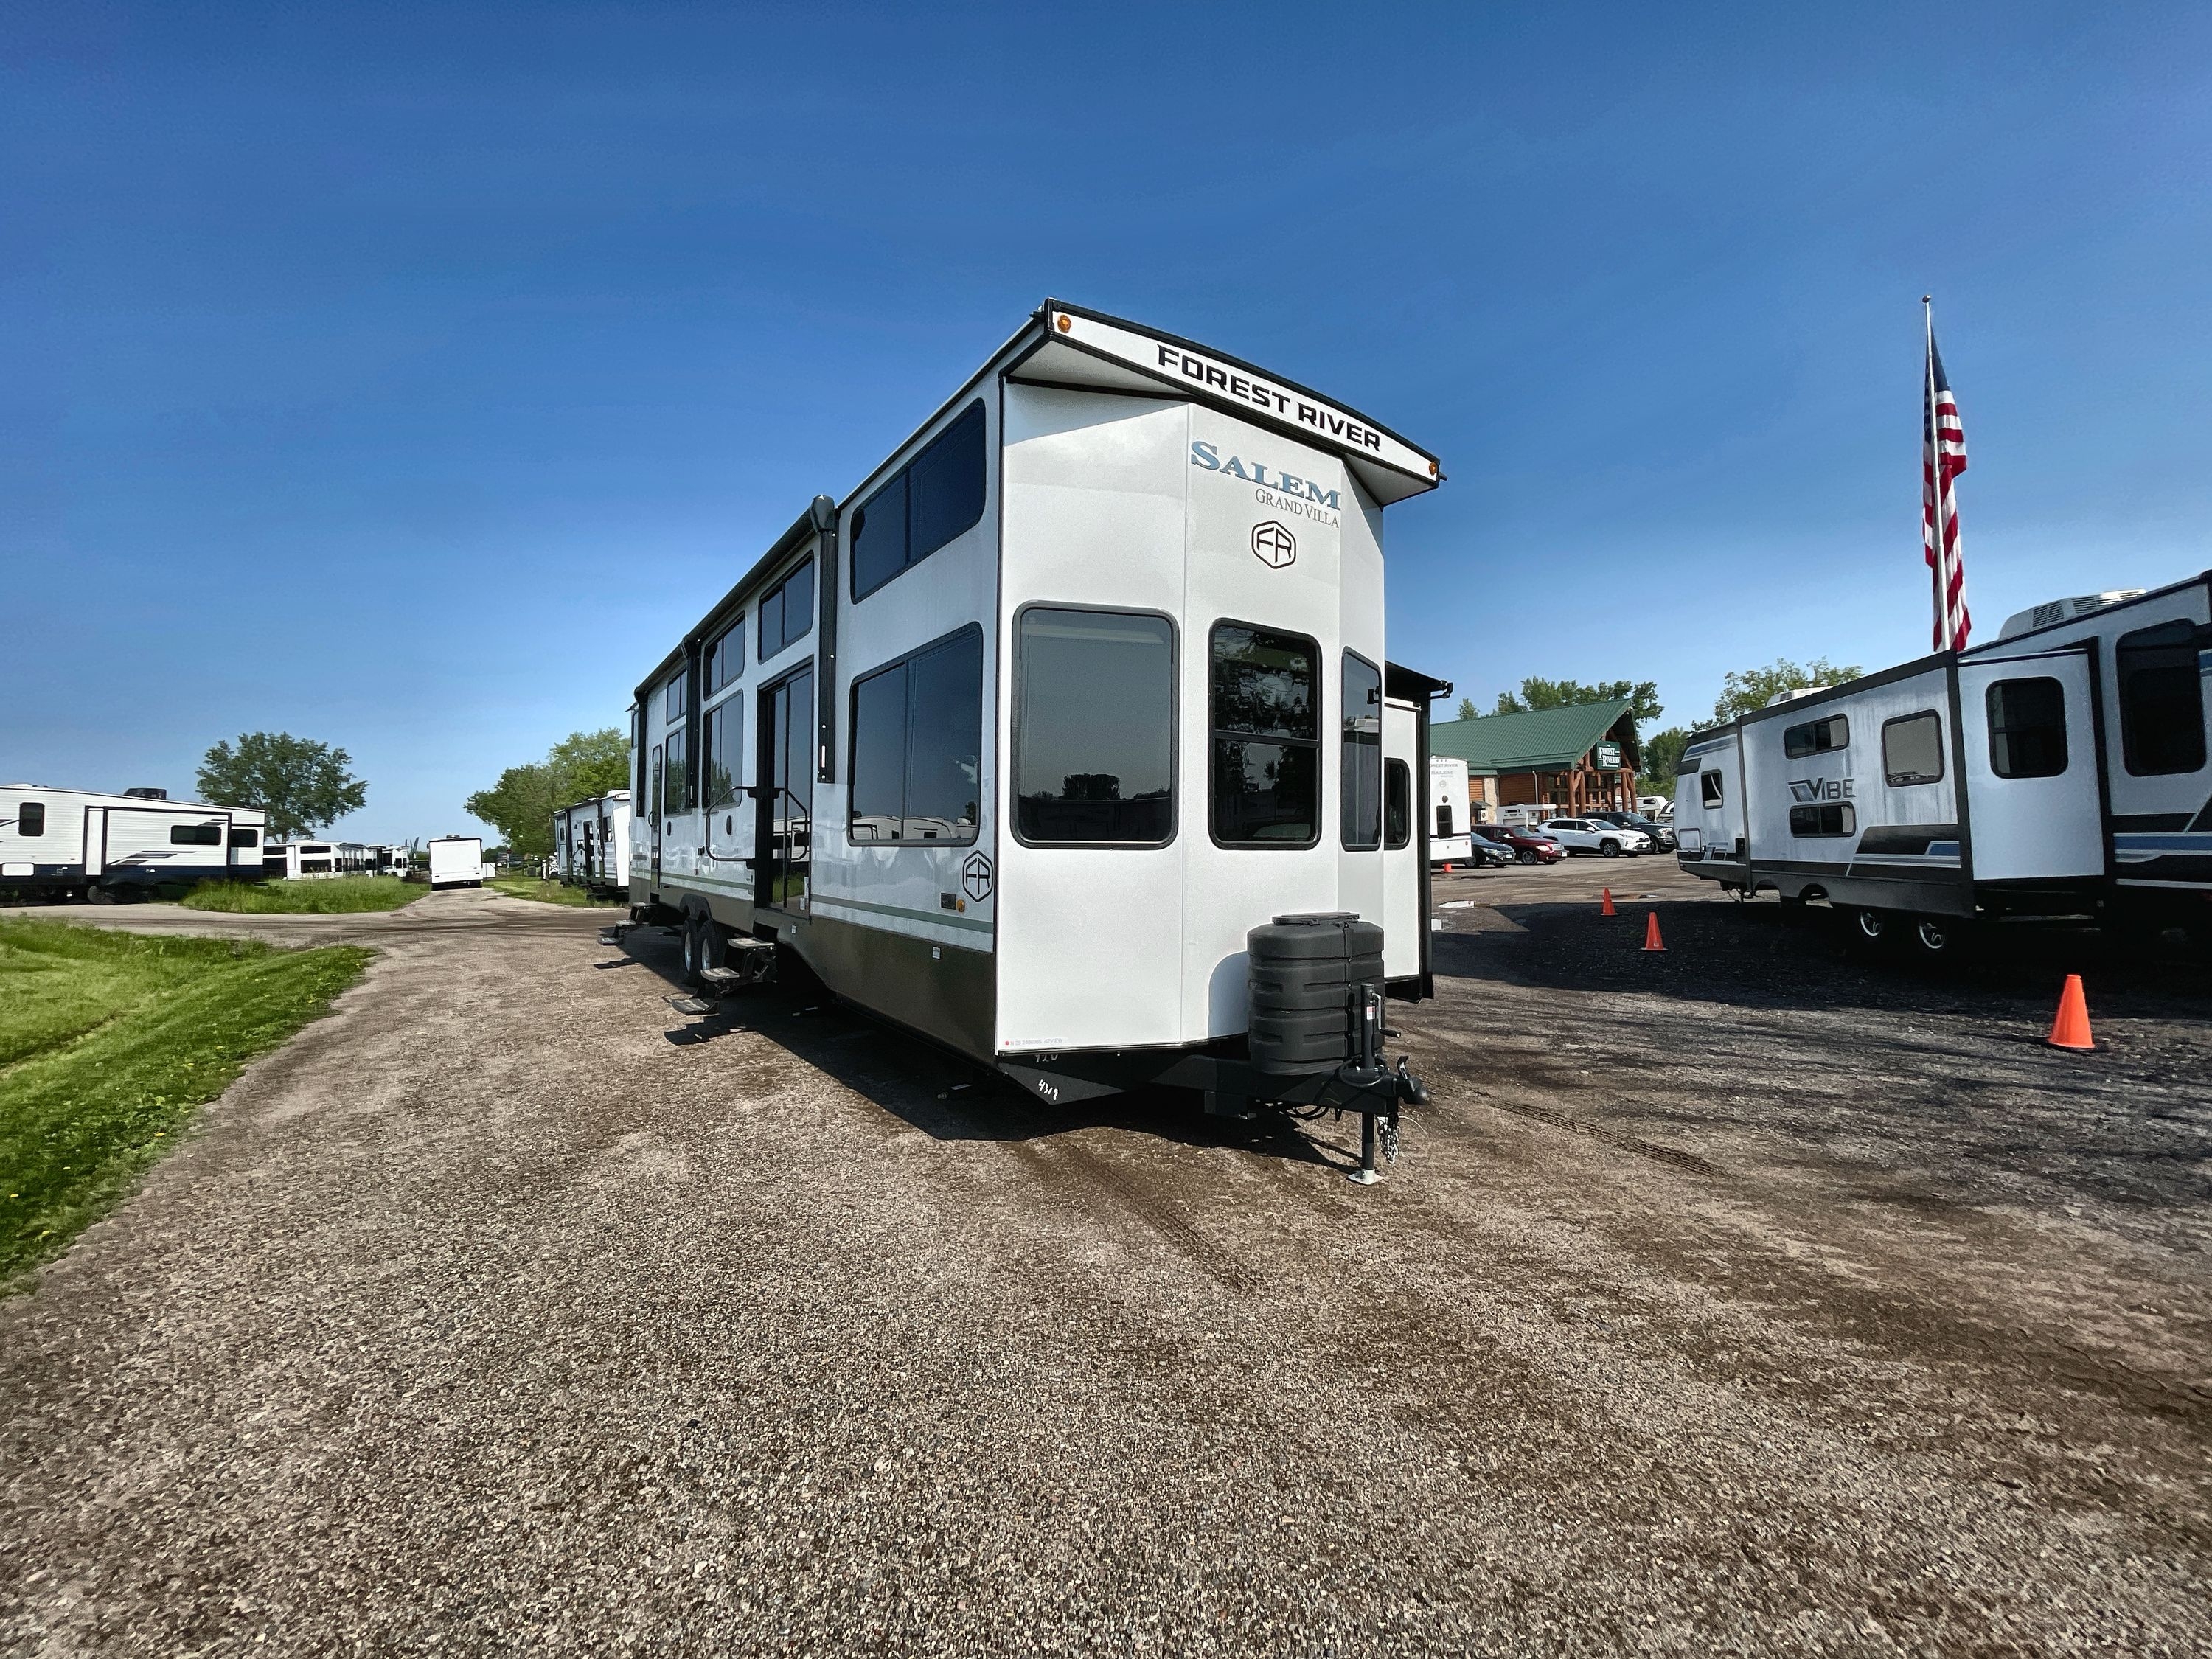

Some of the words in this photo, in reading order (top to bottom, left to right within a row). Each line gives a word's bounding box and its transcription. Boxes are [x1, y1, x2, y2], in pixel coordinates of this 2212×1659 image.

[1157, 344, 1290, 414] FOREST
[1298, 402, 1380, 452] RIVER
[1191, 441, 1341, 511] SALEM
[1255, 488, 1303, 515] GRAND
[1304, 504, 1340, 529] VILLA
[1599, 747, 1615, 759] FOREST
[1787, 777, 1856, 803] VIBE
[1038, 1079, 1059, 1101] 4319
